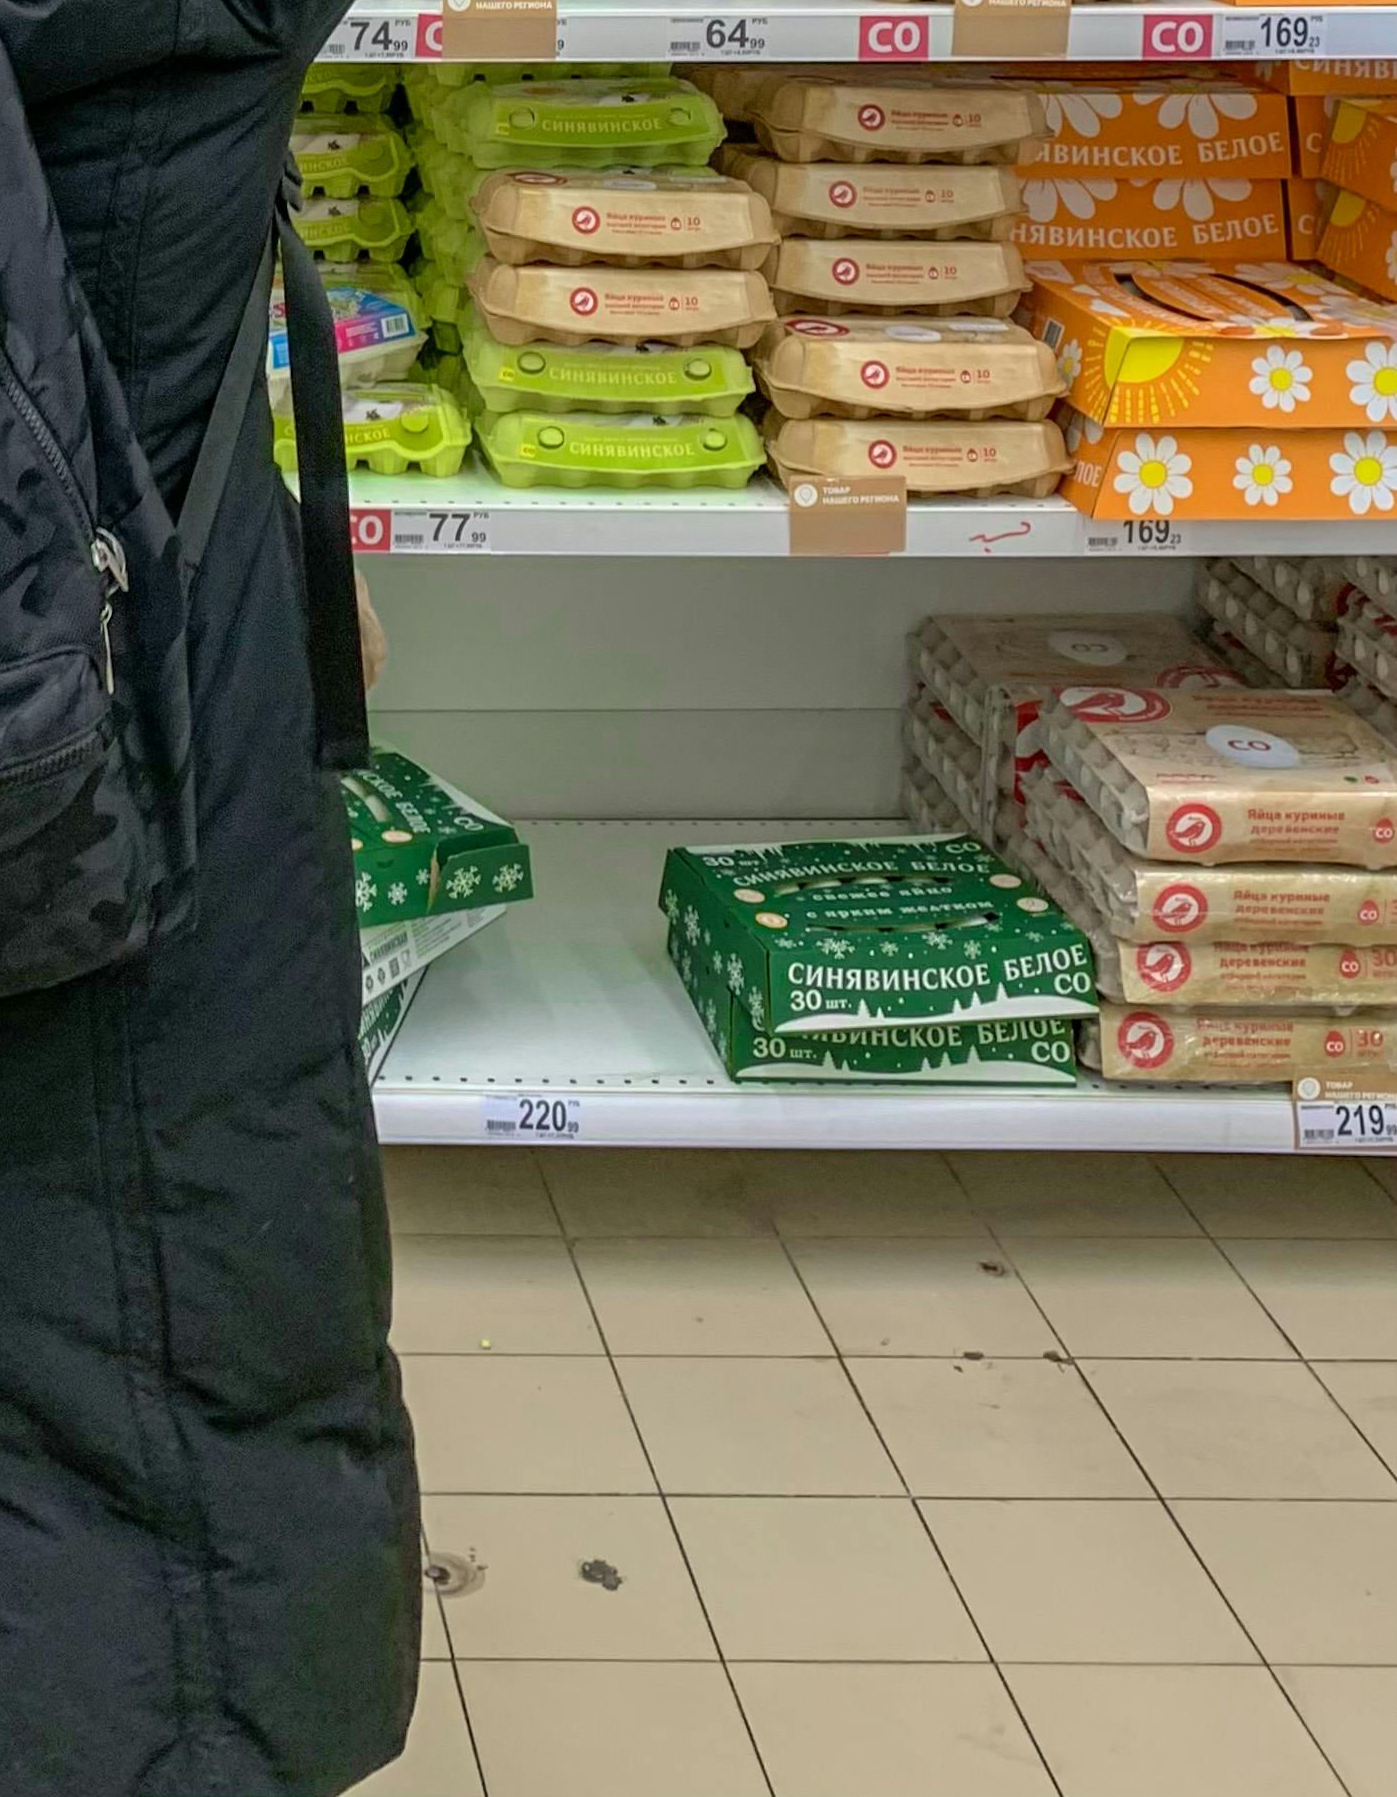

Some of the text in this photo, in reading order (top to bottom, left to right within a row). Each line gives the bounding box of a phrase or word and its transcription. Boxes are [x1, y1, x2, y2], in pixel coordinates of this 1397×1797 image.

[476, 2, 552, 10] НАШЕГО РЕГИОНА
[350, 22, 408, 51] 74 99
[706, 19, 765, 48] 64 99
[1261, 17, 1320, 47] 169 23
[1198, 132, 1284, 161] БЕЛОЕ
[1192, 214, 1280, 246] БЕЛОЕ
[429, 513, 486, 542] 77 99
[1123, 520, 1170, 544] 169
[1248, 810, 1345, 821] Яйца куриные
[703, 856, 735, 867] 30
[733, 861, 991, 887] СИНЯВИНСКОЕ БЕЛОЕ
[1233, 891, 1330, 903] Яйца куриные
[788, 944, 1087, 992] СИНЯВИНСКОЕ БЕЛОЕ
[1219, 957, 1306, 968] деревенские
[790, 990, 852, 1011] 30 шт.
[753, 1038, 785, 1059] 30
[519, 1099, 566, 1131] 220
[1336, 1105, 1384, 1136] 219
